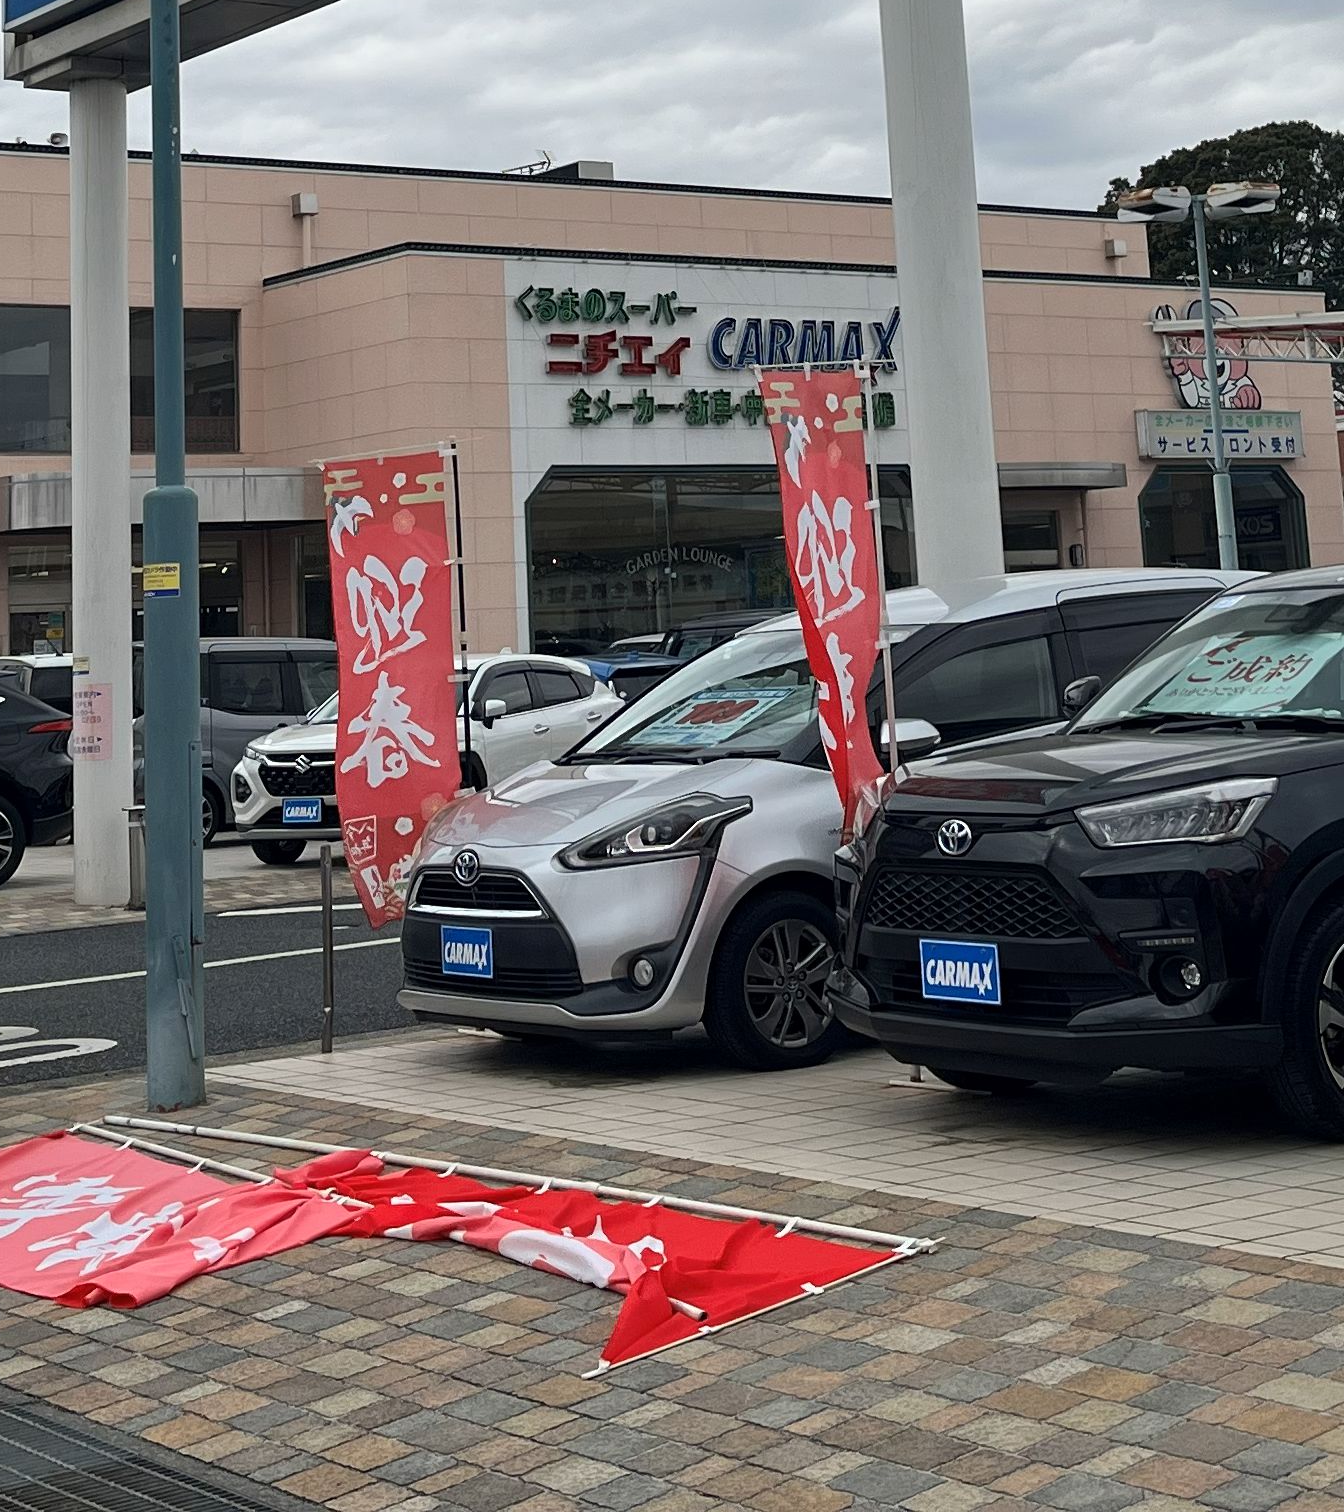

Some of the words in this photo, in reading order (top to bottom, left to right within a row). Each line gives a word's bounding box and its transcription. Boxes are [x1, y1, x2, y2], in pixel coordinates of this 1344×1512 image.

[513, 285, 698, 326] くるまのスーパー
[545, 329, 692, 377] ニチエイ
[706, 305, 901, 372] CARMAX
[1157, 436, 1296, 454] サービスロント受付
[625, 546, 679, 575] GARDEN
[682, 546, 735, 573] LOUNGE
[1186, 653, 1314, 683] ご成約
[284, 804, 321, 820] CARMAX
[443, 939, 490, 970] CARMAX
[925, 957, 995, 994] CARMAX
